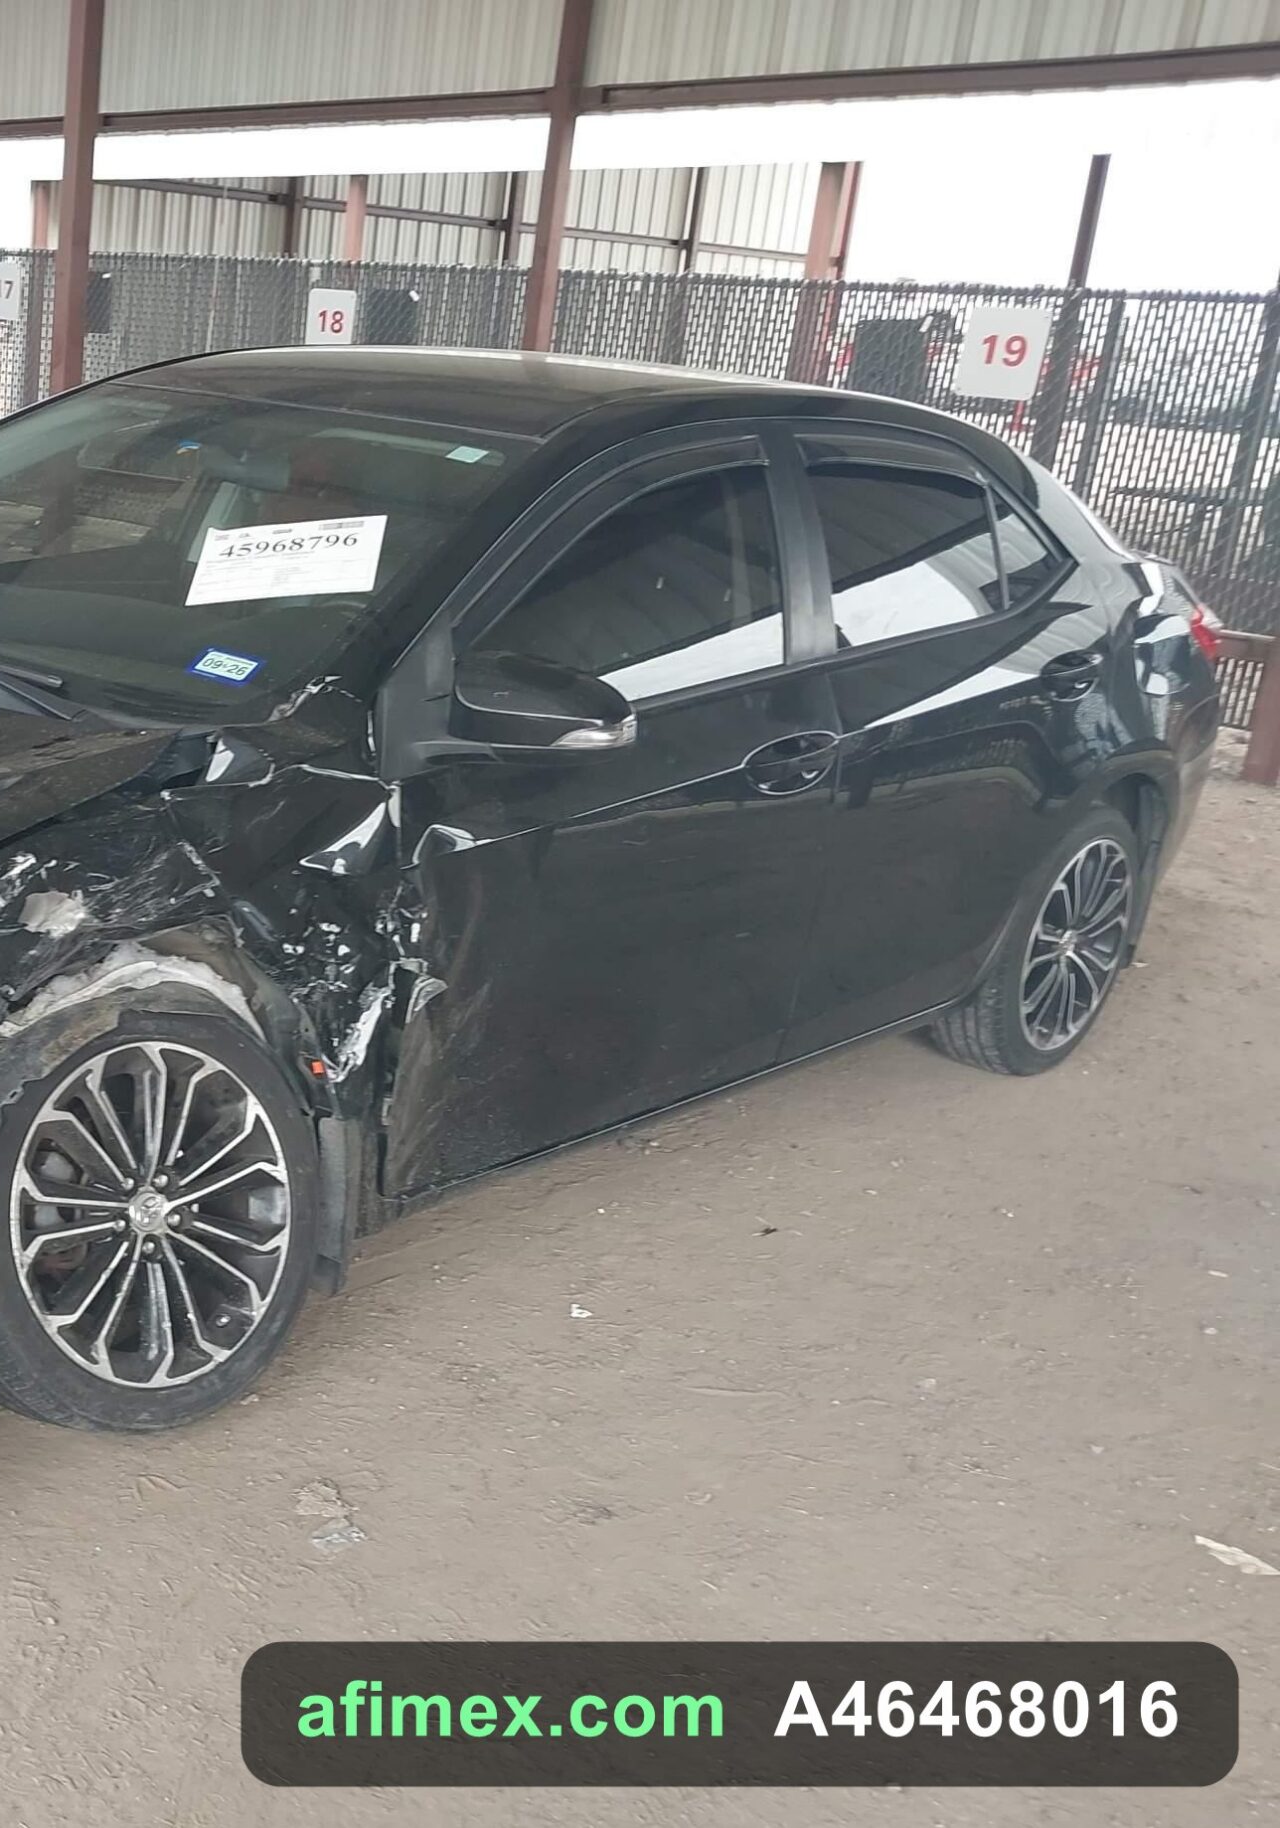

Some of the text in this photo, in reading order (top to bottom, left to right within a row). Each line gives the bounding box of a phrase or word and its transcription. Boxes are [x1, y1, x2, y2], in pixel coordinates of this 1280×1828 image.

[319, 310, 344, 333] 18
[982, 335, 1027, 366] 19
[219, 533, 359, 558] 45968796
